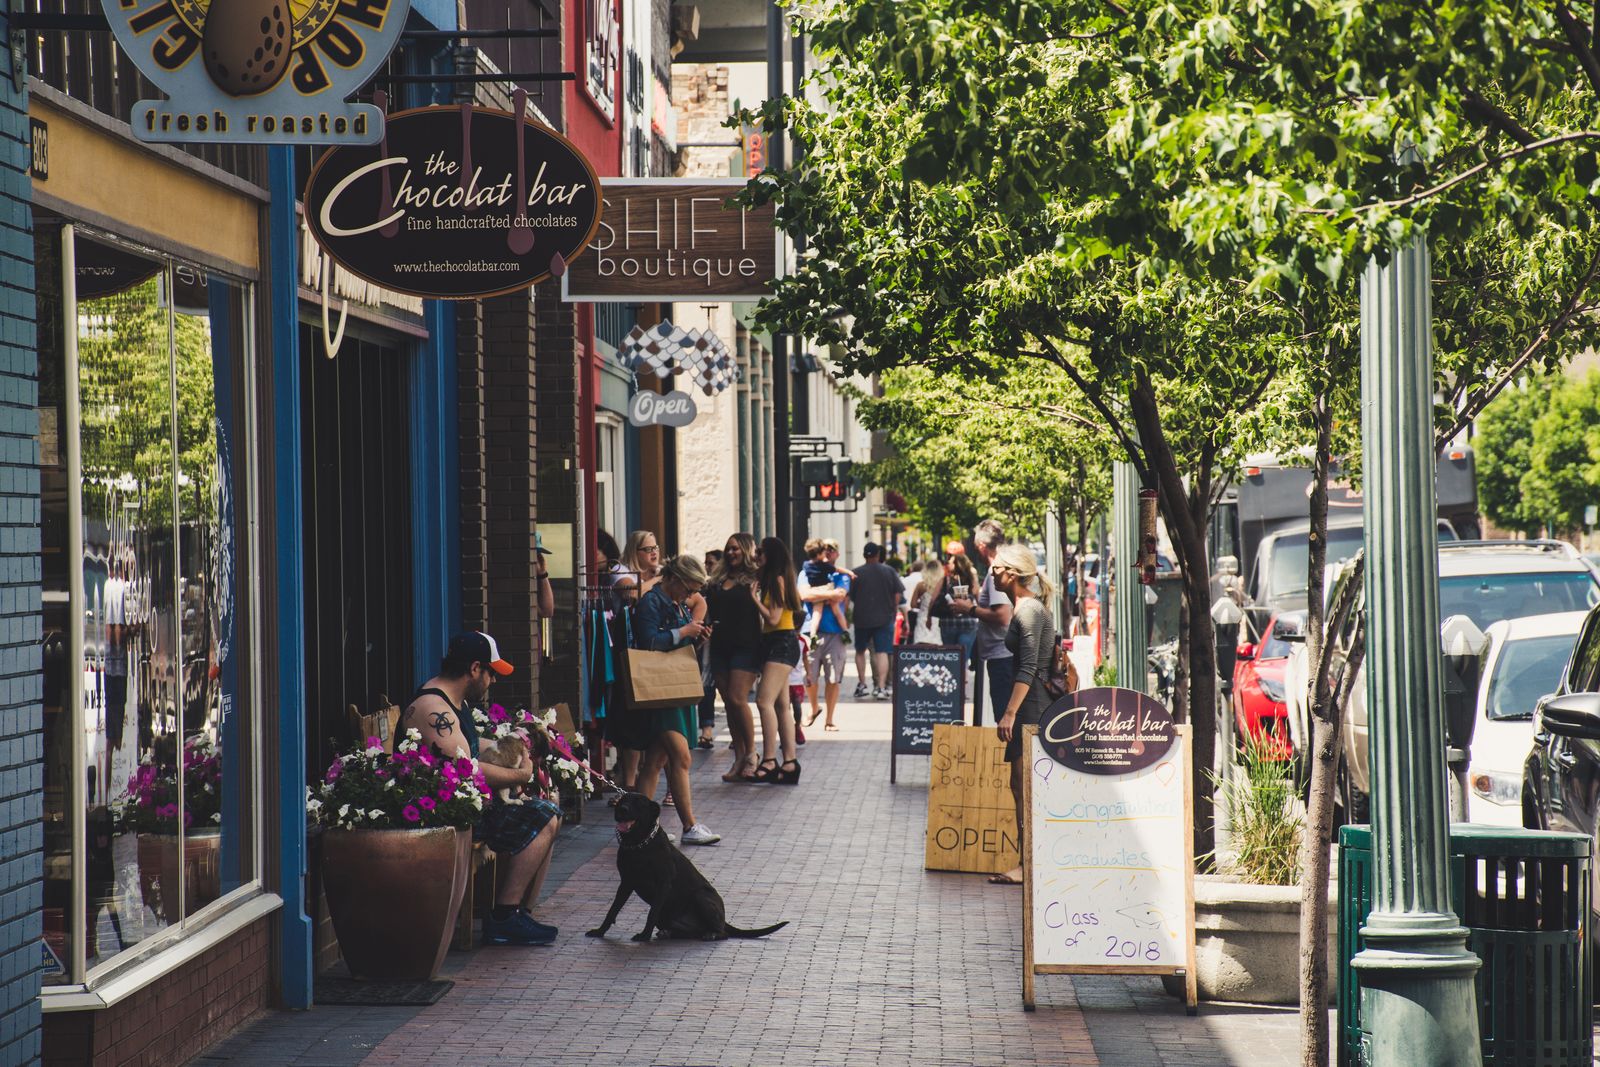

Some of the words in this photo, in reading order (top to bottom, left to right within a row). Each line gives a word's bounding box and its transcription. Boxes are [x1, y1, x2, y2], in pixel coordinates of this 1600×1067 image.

[119, 0, 201, 71] CI
[145, 108, 229, 132] fresh
[247, 112, 368, 135] roasted
[32, 126, 48, 174] 803
[424, 150, 459, 176] the
[320, 156, 512, 237] Chocolat
[527, 161, 586, 206] bar
[407, 216, 432, 231] fine
[436, 214, 511, 230] handcrafted
[514, 213, 577, 229] chocolates
[393, 260, 520, 273] www.thechocolatbar.com
[598, 239, 757, 287] boutique
[633, 392, 691, 424] Open
[1044, 706, 1135, 743] Chocolat
[1142, 710, 1169, 731] bar
[1093, 704, 1110, 717] the
[1084, 734, 1097, 742] fine
[1098, 733, 1135, 742] handcrafted
[1136, 733, 1168, 742] chocolates
[934, 743, 1007, 773] SHIF
[940, 769, 1011, 793] boutiq
[935, 827, 1020, 854] OPEN
[1051, 834, 1153, 867] Graduates
[1044, 901, 1100, 928] Class
[1065, 930, 1086, 947] of
[1105, 936, 1161, 961] 2018
